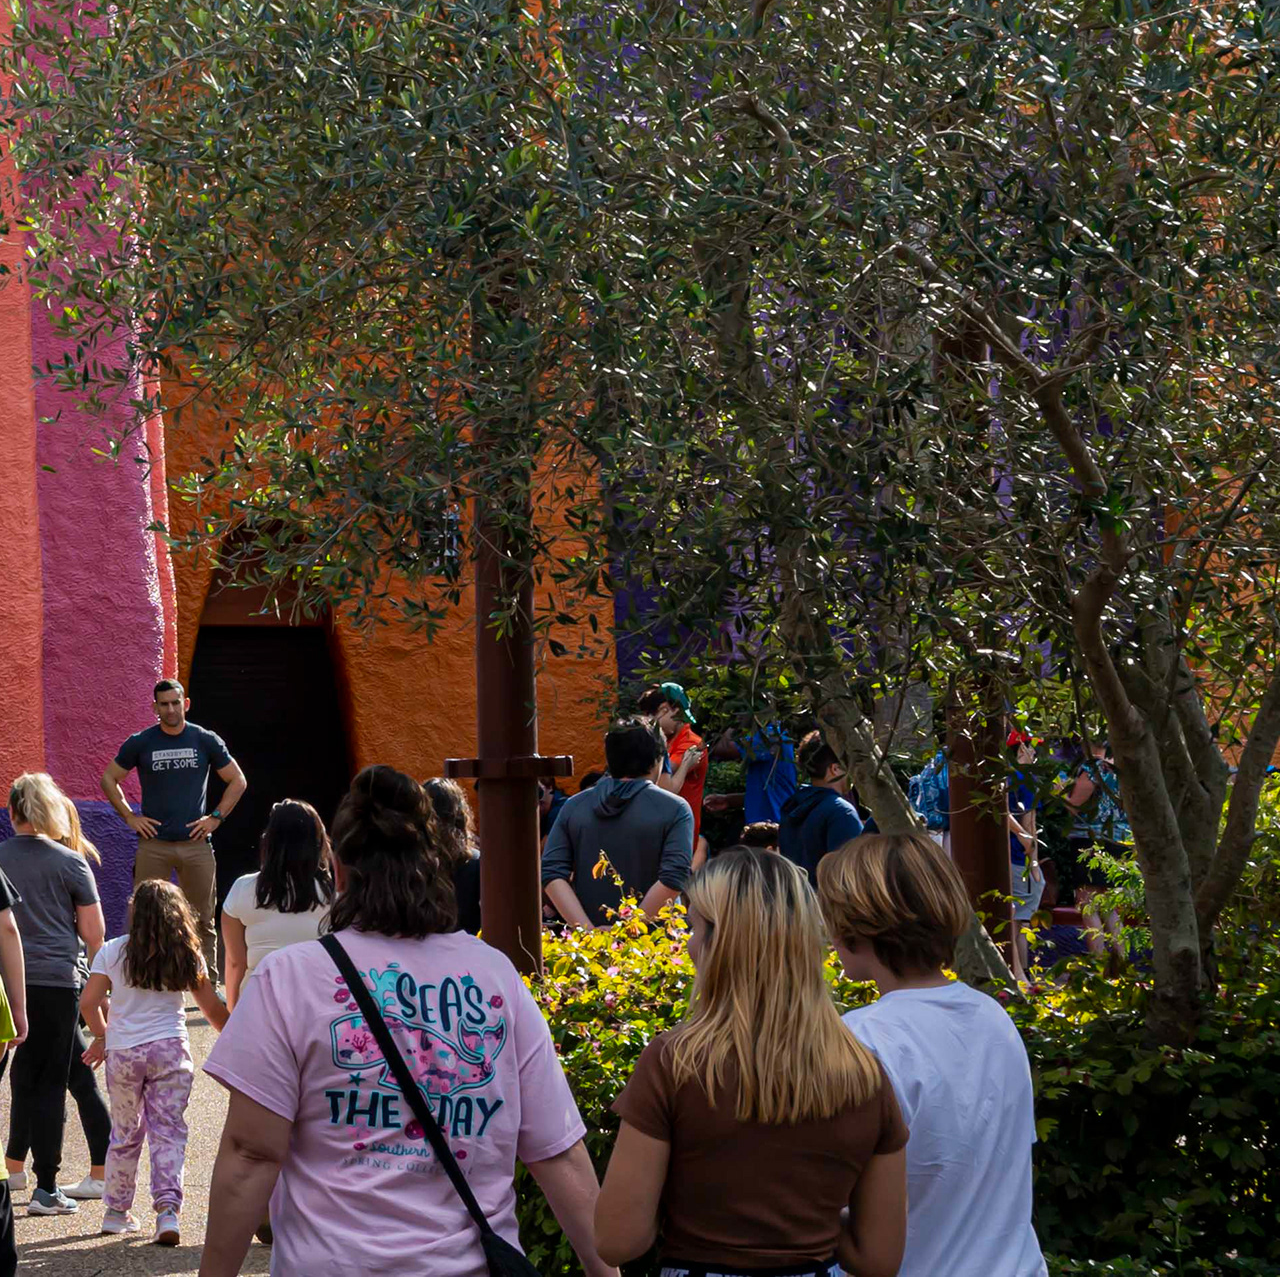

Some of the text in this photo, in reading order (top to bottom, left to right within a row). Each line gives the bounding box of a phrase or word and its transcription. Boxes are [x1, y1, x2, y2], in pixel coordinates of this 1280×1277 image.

[152, 758, 199, 771] GET SOME
[396, 973, 486, 1031] SEAS
[325, 1090, 504, 1136] THE DAY
